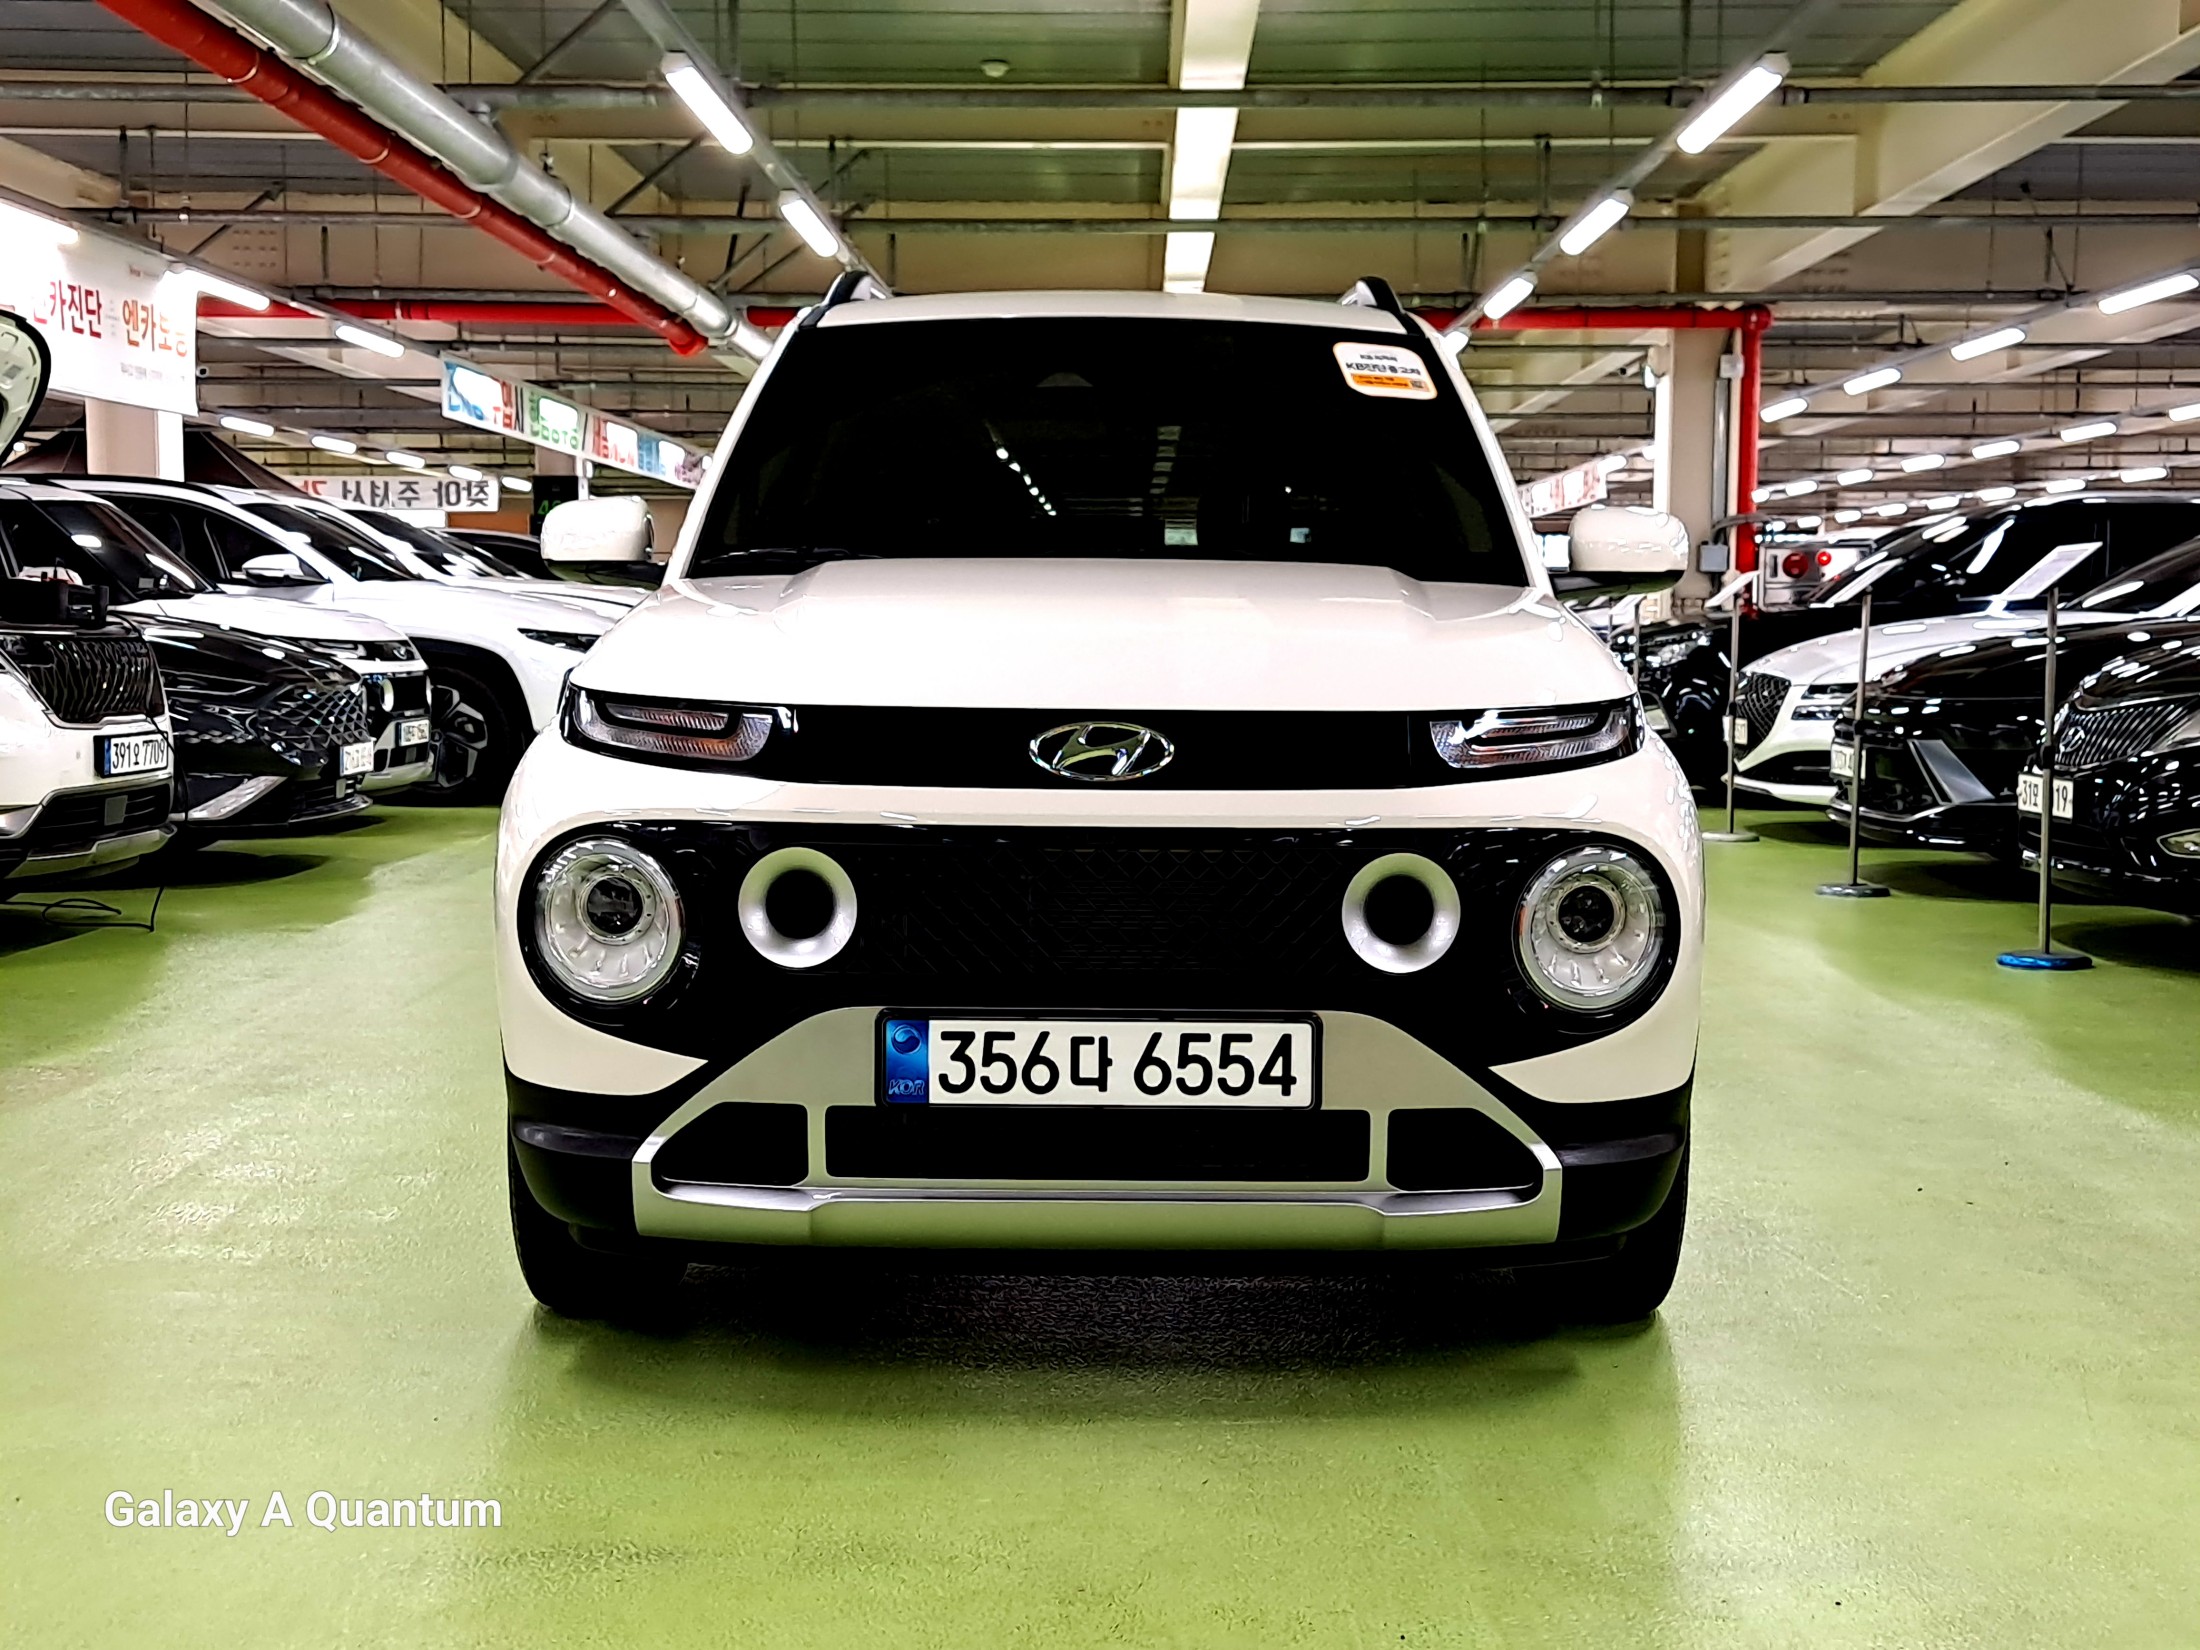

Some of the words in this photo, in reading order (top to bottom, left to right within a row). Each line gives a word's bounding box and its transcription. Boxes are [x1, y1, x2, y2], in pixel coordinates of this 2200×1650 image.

[33, 280, 102, 339] 카진단
[112, 741, 140, 769] 391오
[142, 738, 165, 766] 7709
[938, 1031, 1113, 1095] 356다
[1133, 1032, 1297, 1097] 6554
[888, 1079, 925, 1096] KOR
